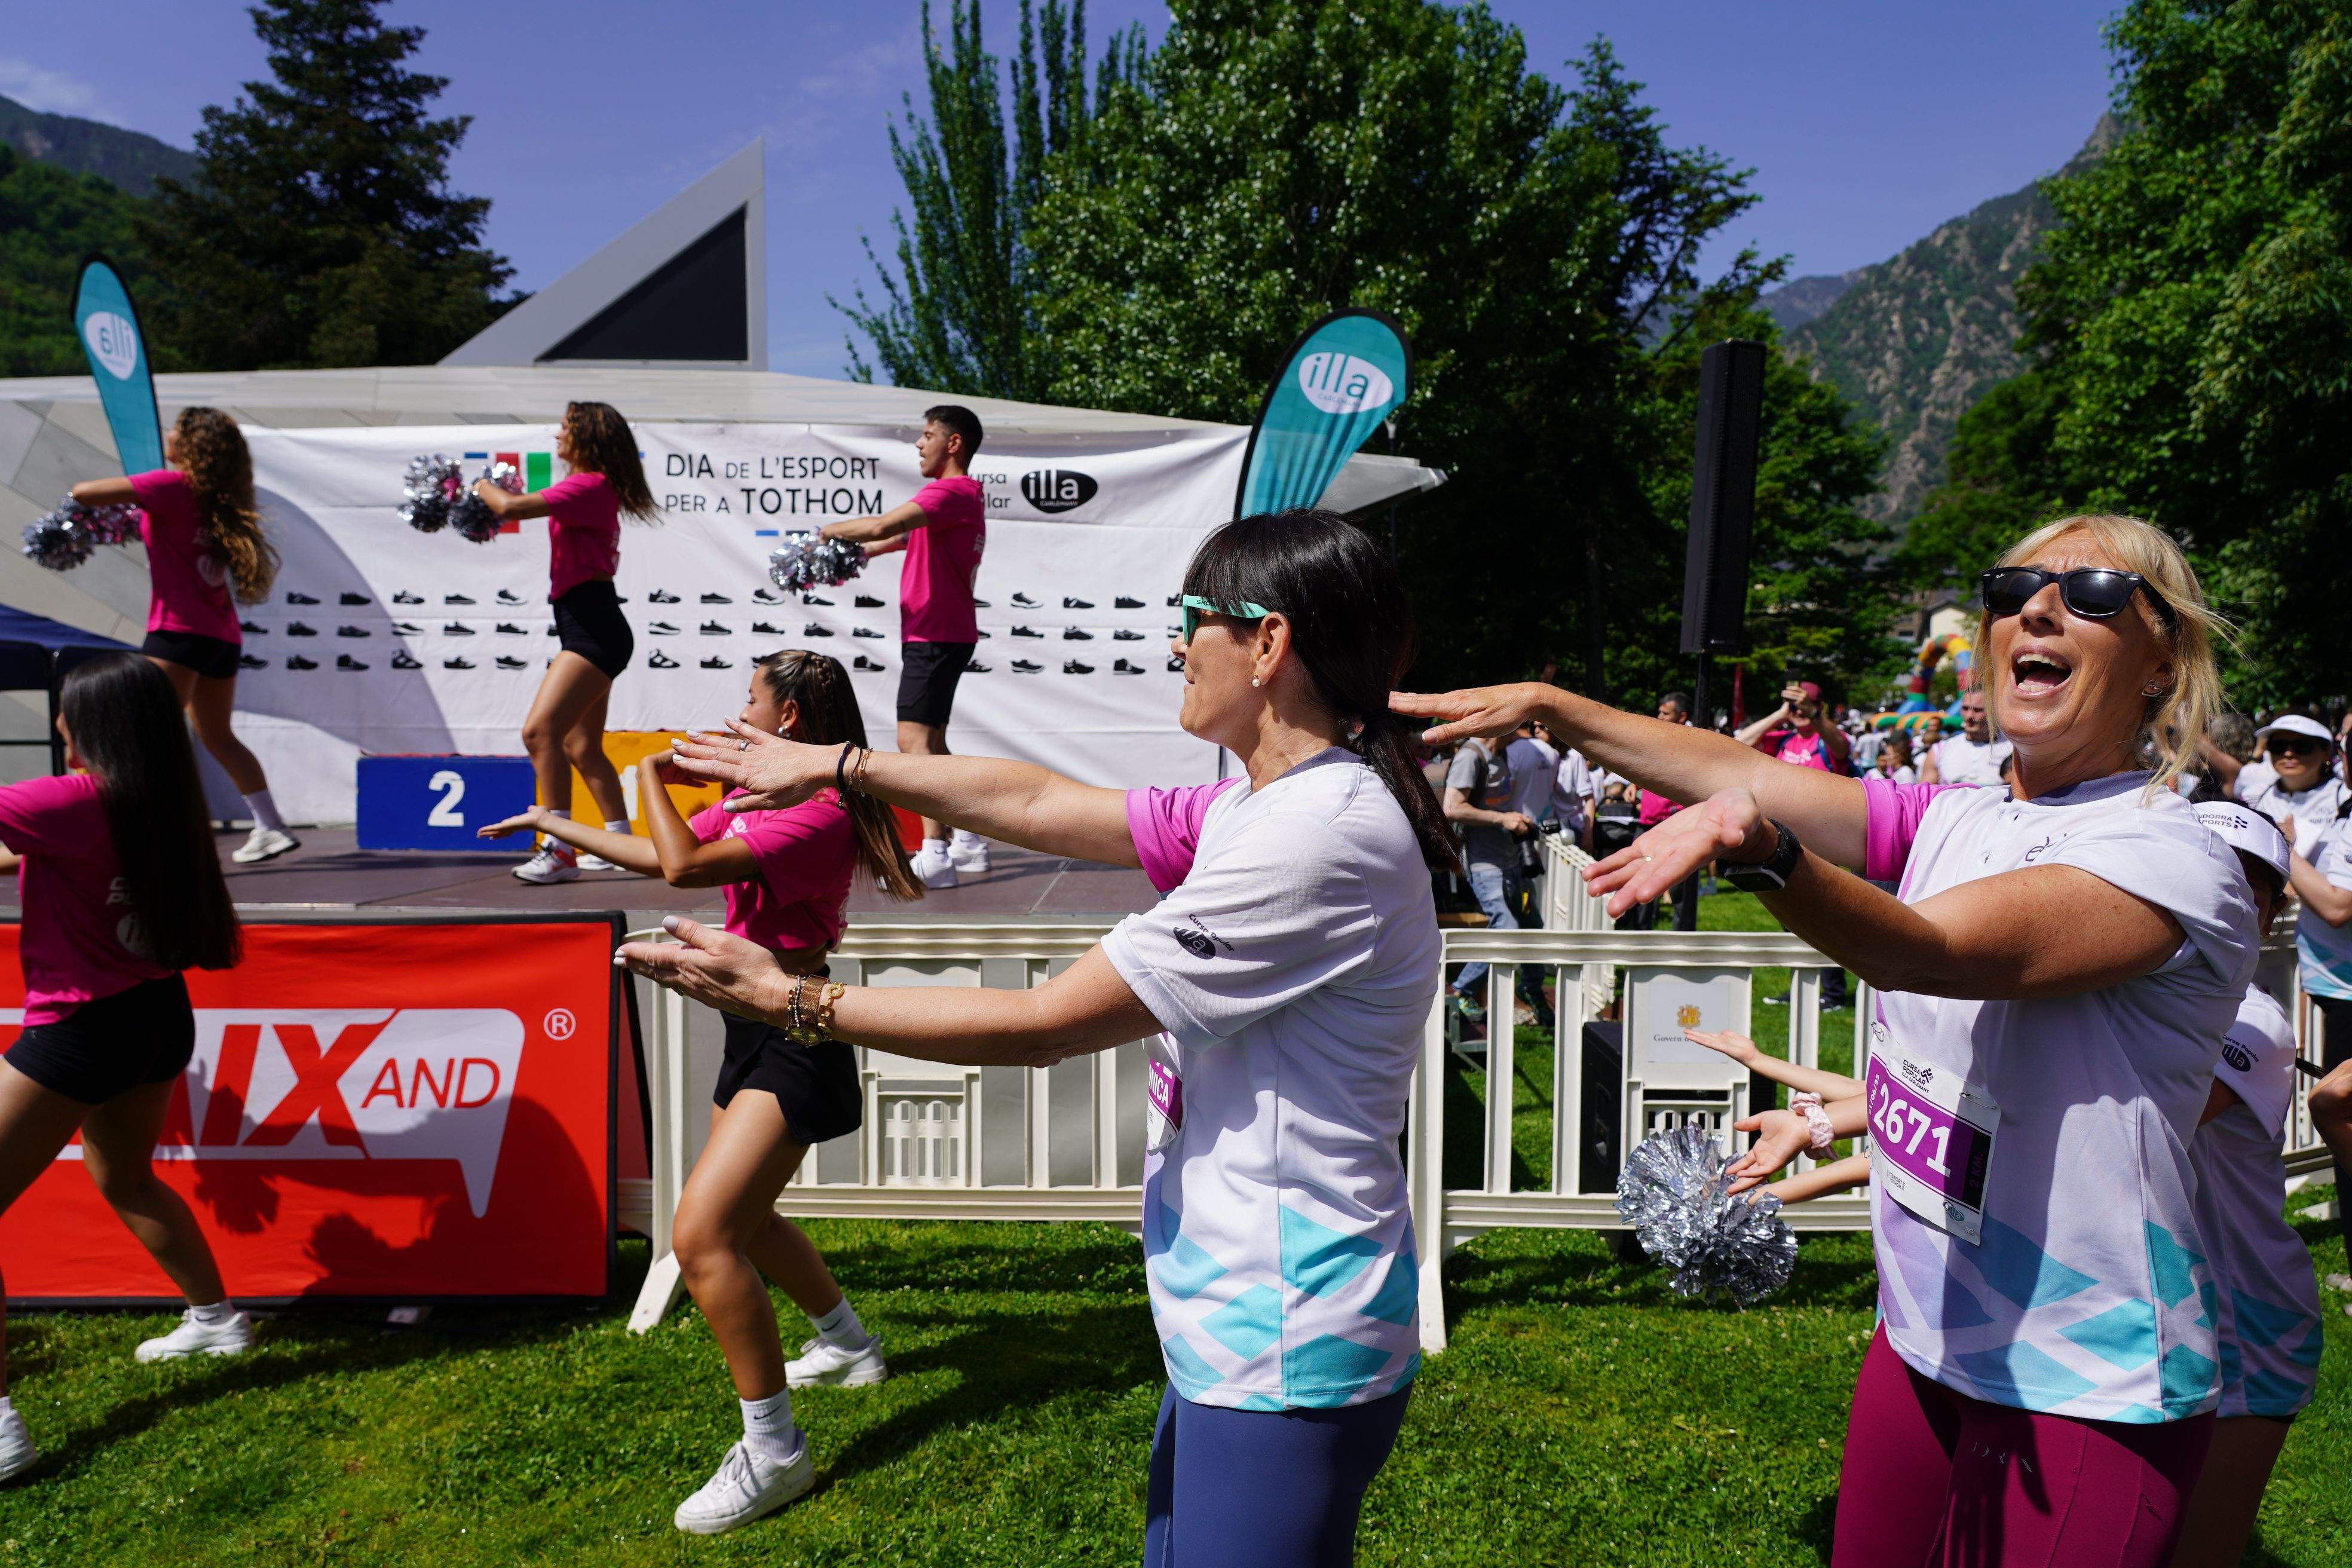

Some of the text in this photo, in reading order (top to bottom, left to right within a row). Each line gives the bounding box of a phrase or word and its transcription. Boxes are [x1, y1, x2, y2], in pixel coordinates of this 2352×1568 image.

[1308, 351, 1368, 400] illa
[666, 454, 880, 479] DIA DE L'ESPORT
[1028, 469, 1079, 500] illa
[666, 488, 882, 514] PER A TOTHOM
[427, 770, 465, 826] 2
[619, 765, 639, 820] 1
[1903, 1059, 1920, 1075] CURSA
[2224, 1045, 2245, 1067] illa
[2241, 1044, 2259, 1062] Popular
[360, 1058, 501, 1109] AND
[1903, 1065, 1926, 1086] POPULAR
[1869, 1074, 1879, 1115] 01/06/25
[1873, 1083, 1951, 1178] 2671
